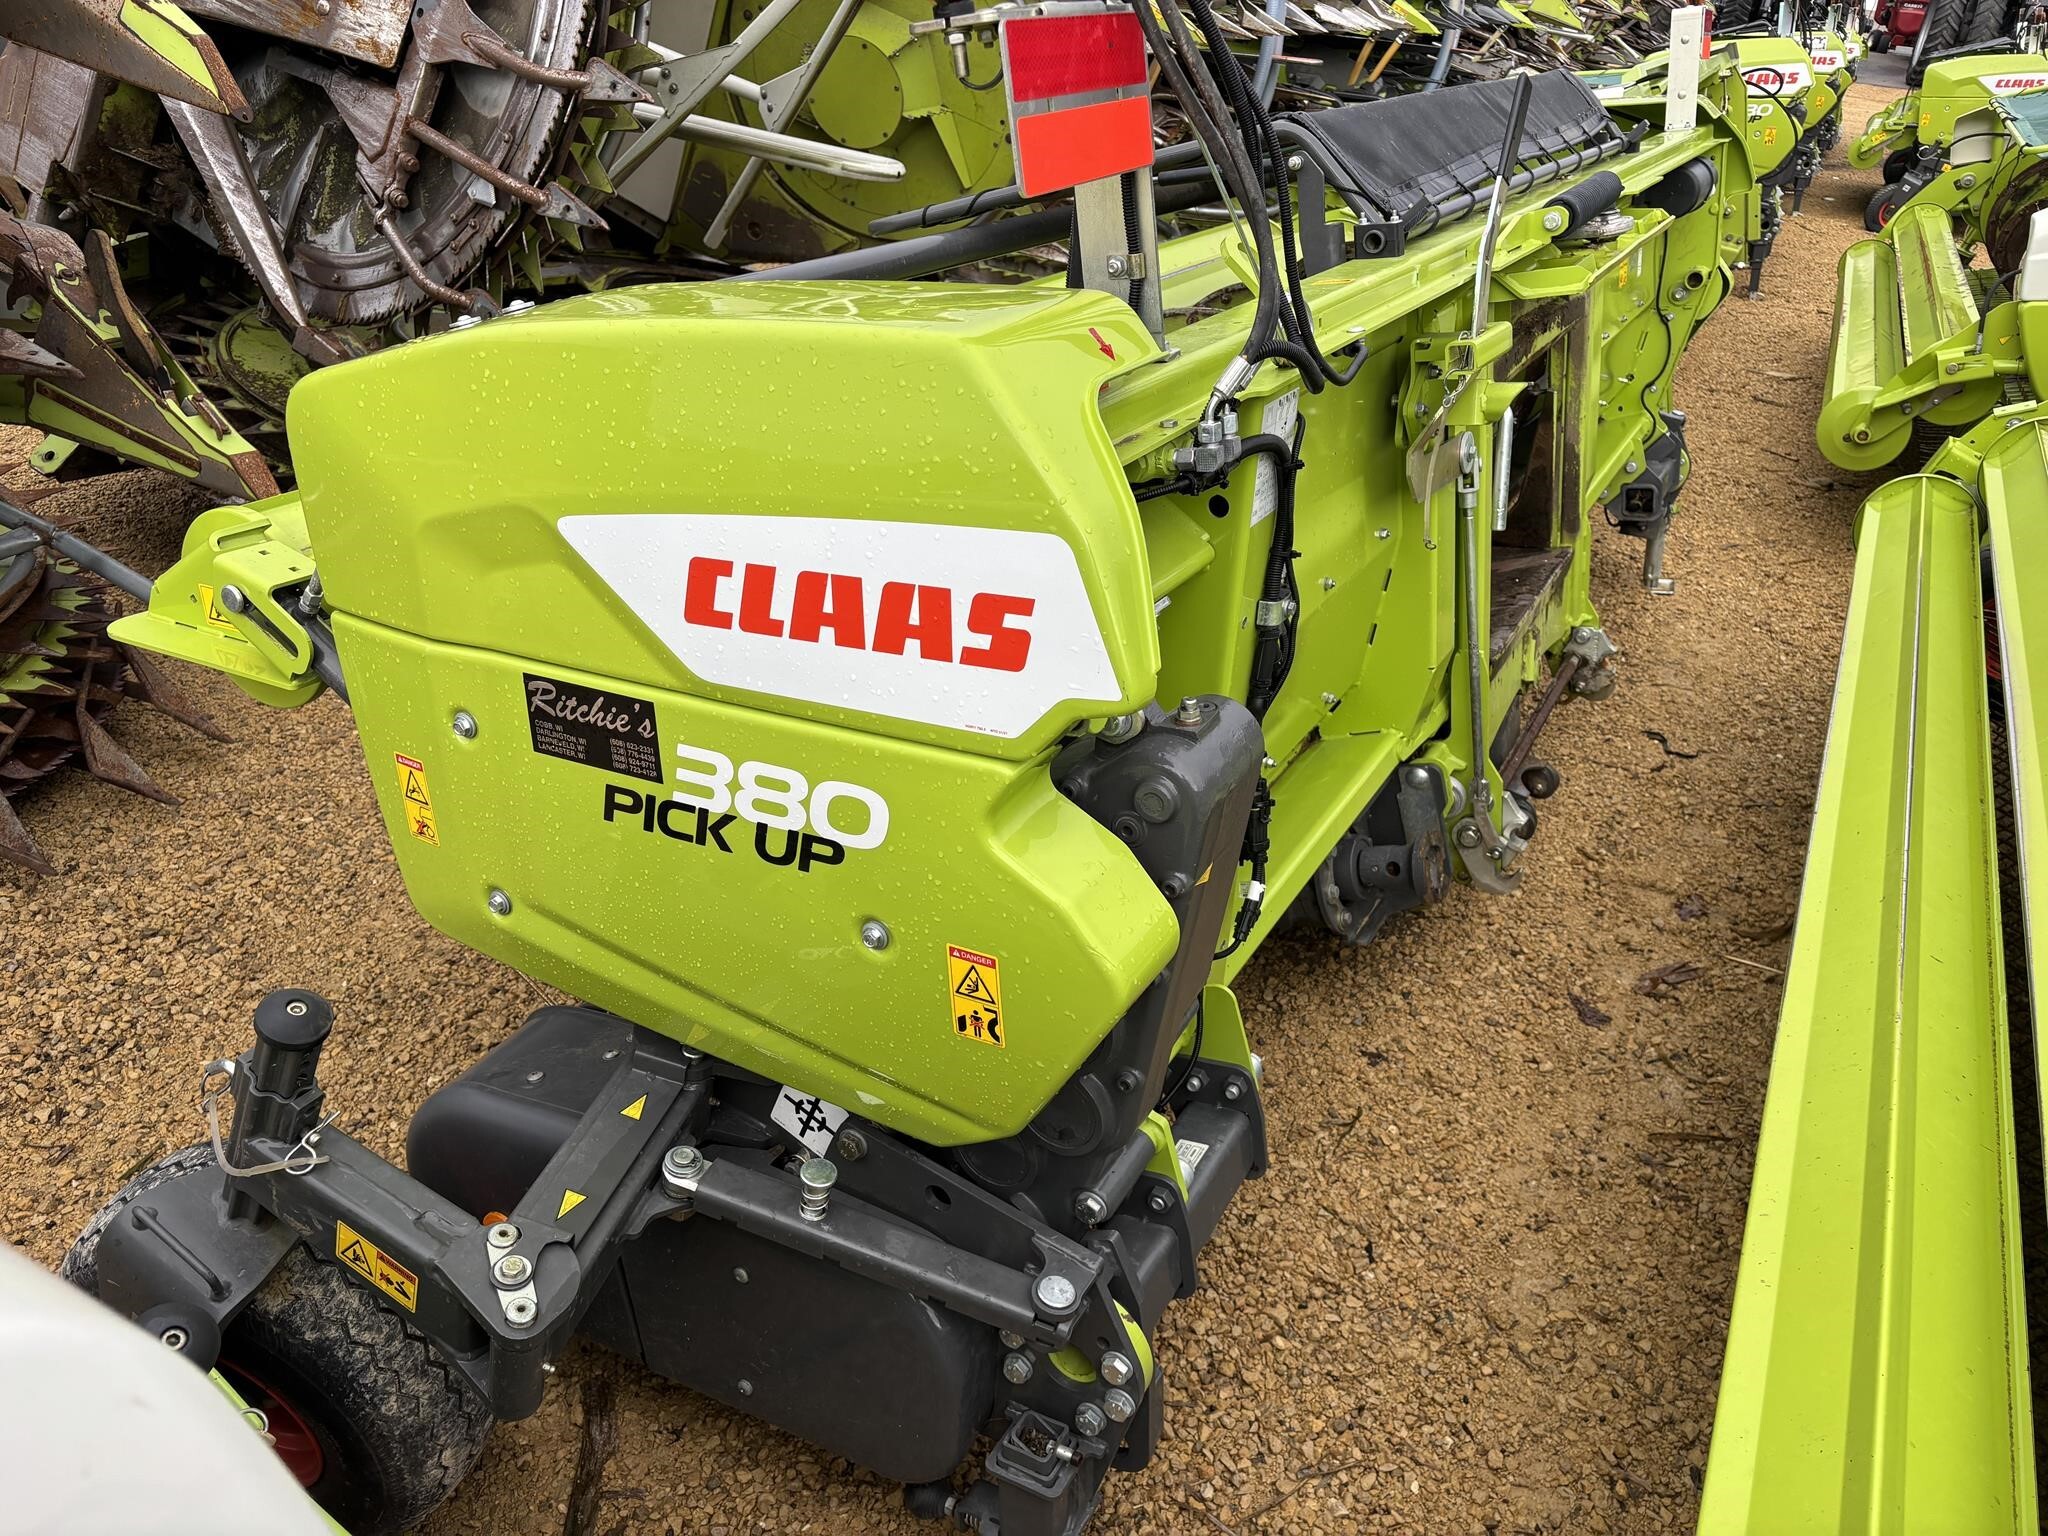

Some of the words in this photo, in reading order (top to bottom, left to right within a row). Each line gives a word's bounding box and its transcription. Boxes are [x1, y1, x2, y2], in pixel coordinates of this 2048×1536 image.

[1747, 73, 1799, 85] LAAS
[1995, 79, 2046, 88] CLAAS
[684, 556, 1036, 673] CLAAS
[527, 680, 655, 739] Ritchie's
[535, 727, 578, 743] DARLINGTON,
[627, 750, 656, 762] 776-4439
[672, 743, 890, 850] 380
[603, 783, 737, 854] PICK
[754, 821, 846, 873] UP
[961, 951, 993, 966] DANGER
